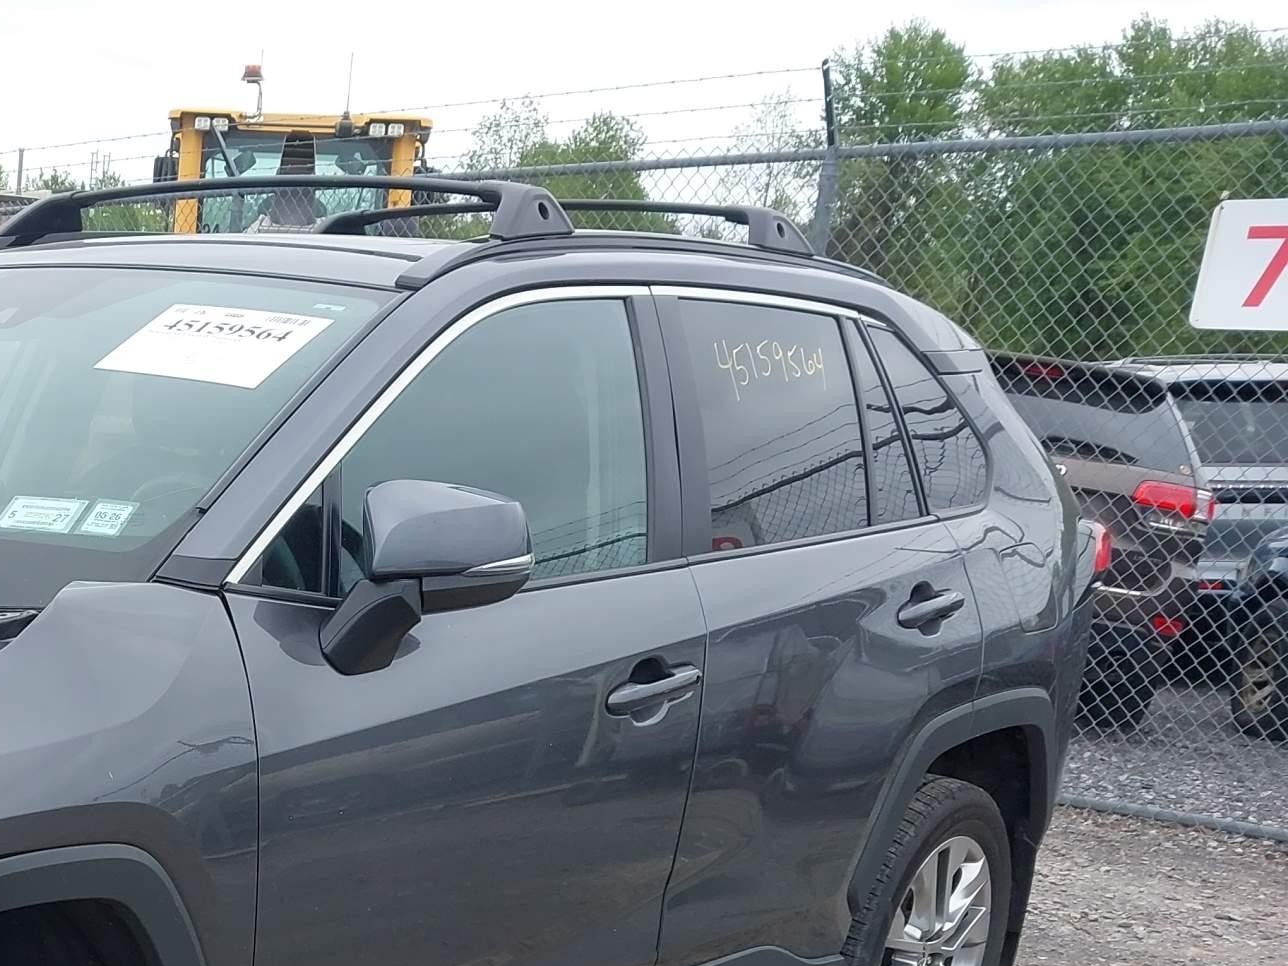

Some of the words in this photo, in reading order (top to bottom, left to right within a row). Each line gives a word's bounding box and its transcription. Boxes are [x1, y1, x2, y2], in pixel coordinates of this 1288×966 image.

[1240, 225, 1288, 307] 7
[163, 318, 294, 342] 45159564
[713, 339, 827, 401] 45159564
